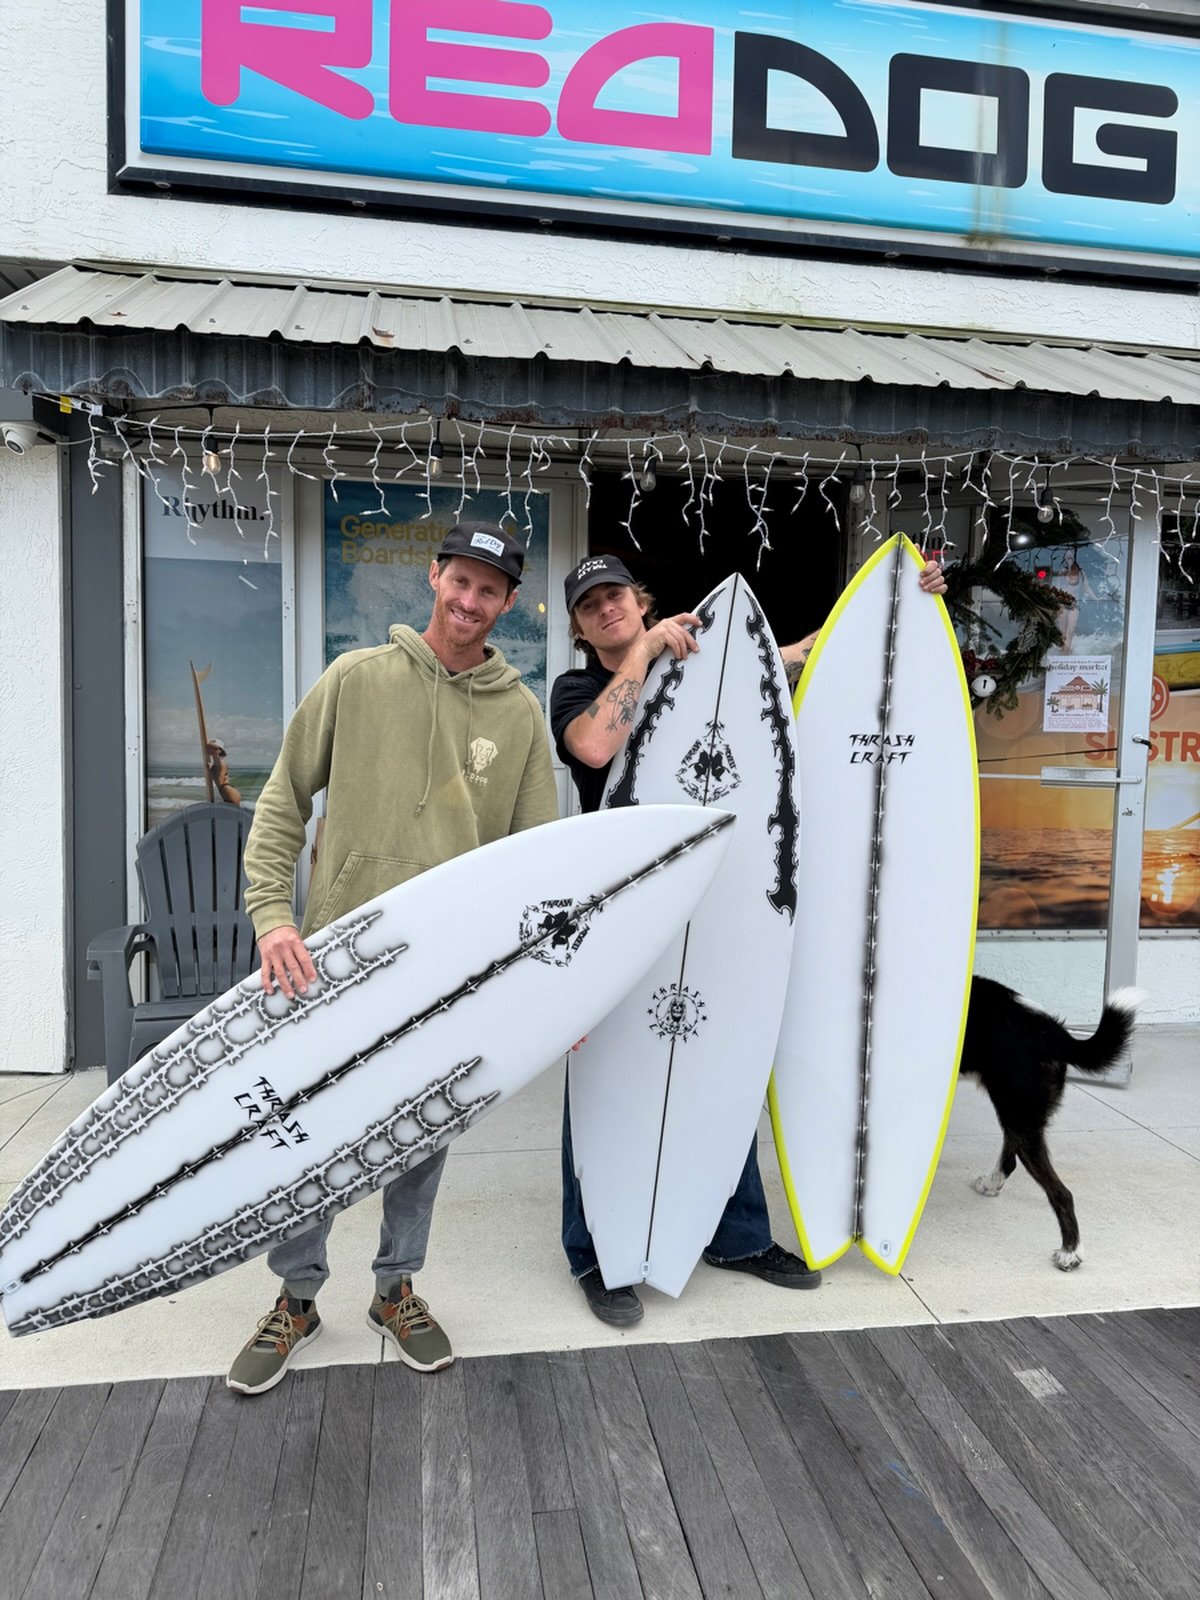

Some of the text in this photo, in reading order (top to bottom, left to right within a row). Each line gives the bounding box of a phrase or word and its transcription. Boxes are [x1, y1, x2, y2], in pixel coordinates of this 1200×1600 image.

[849, 733, 916, 748] THRASH
[850, 751, 913, 766] CRAFT
[233, 1092, 292, 1150] CRAFT
[252, 1075, 311, 1145] THRASH
